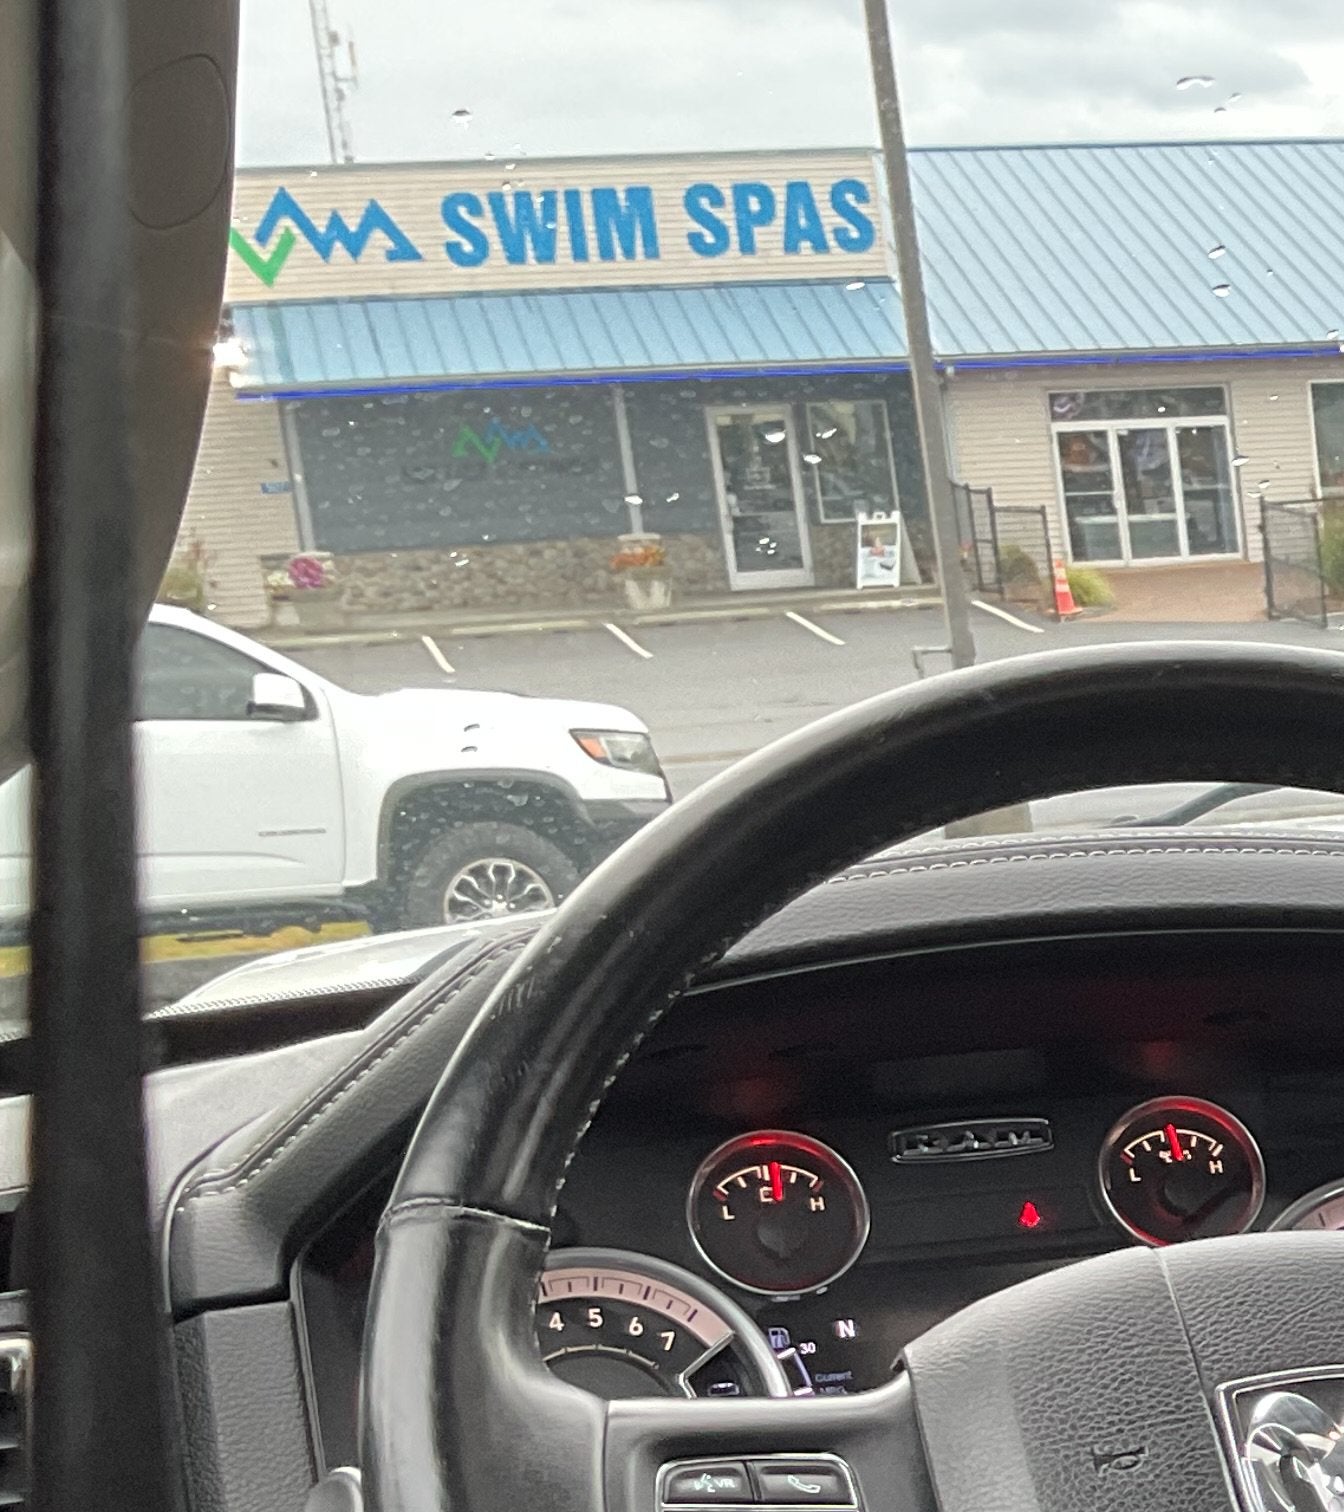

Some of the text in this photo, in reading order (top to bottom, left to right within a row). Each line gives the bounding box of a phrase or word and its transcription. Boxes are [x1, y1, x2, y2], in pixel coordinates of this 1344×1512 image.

[441, 178, 876, 267] SWIM SPAS
[1129, 1168, 1141, 1182] L
[1209, 1160, 1223, 1174] H
[810, 1196, 825, 1211] H
[722, 1205, 735, 1220] L
[549, 1312, 564, 1331] 4
[588, 1308, 603, 1328] 5
[629, 1316, 643, 1336] 6
[837, 1319, 855, 1338] N
[661, 1331, 676, 1351] 7
[800, 1342, 816, 1355] 30
[715, 1478, 735, 1488] VR
